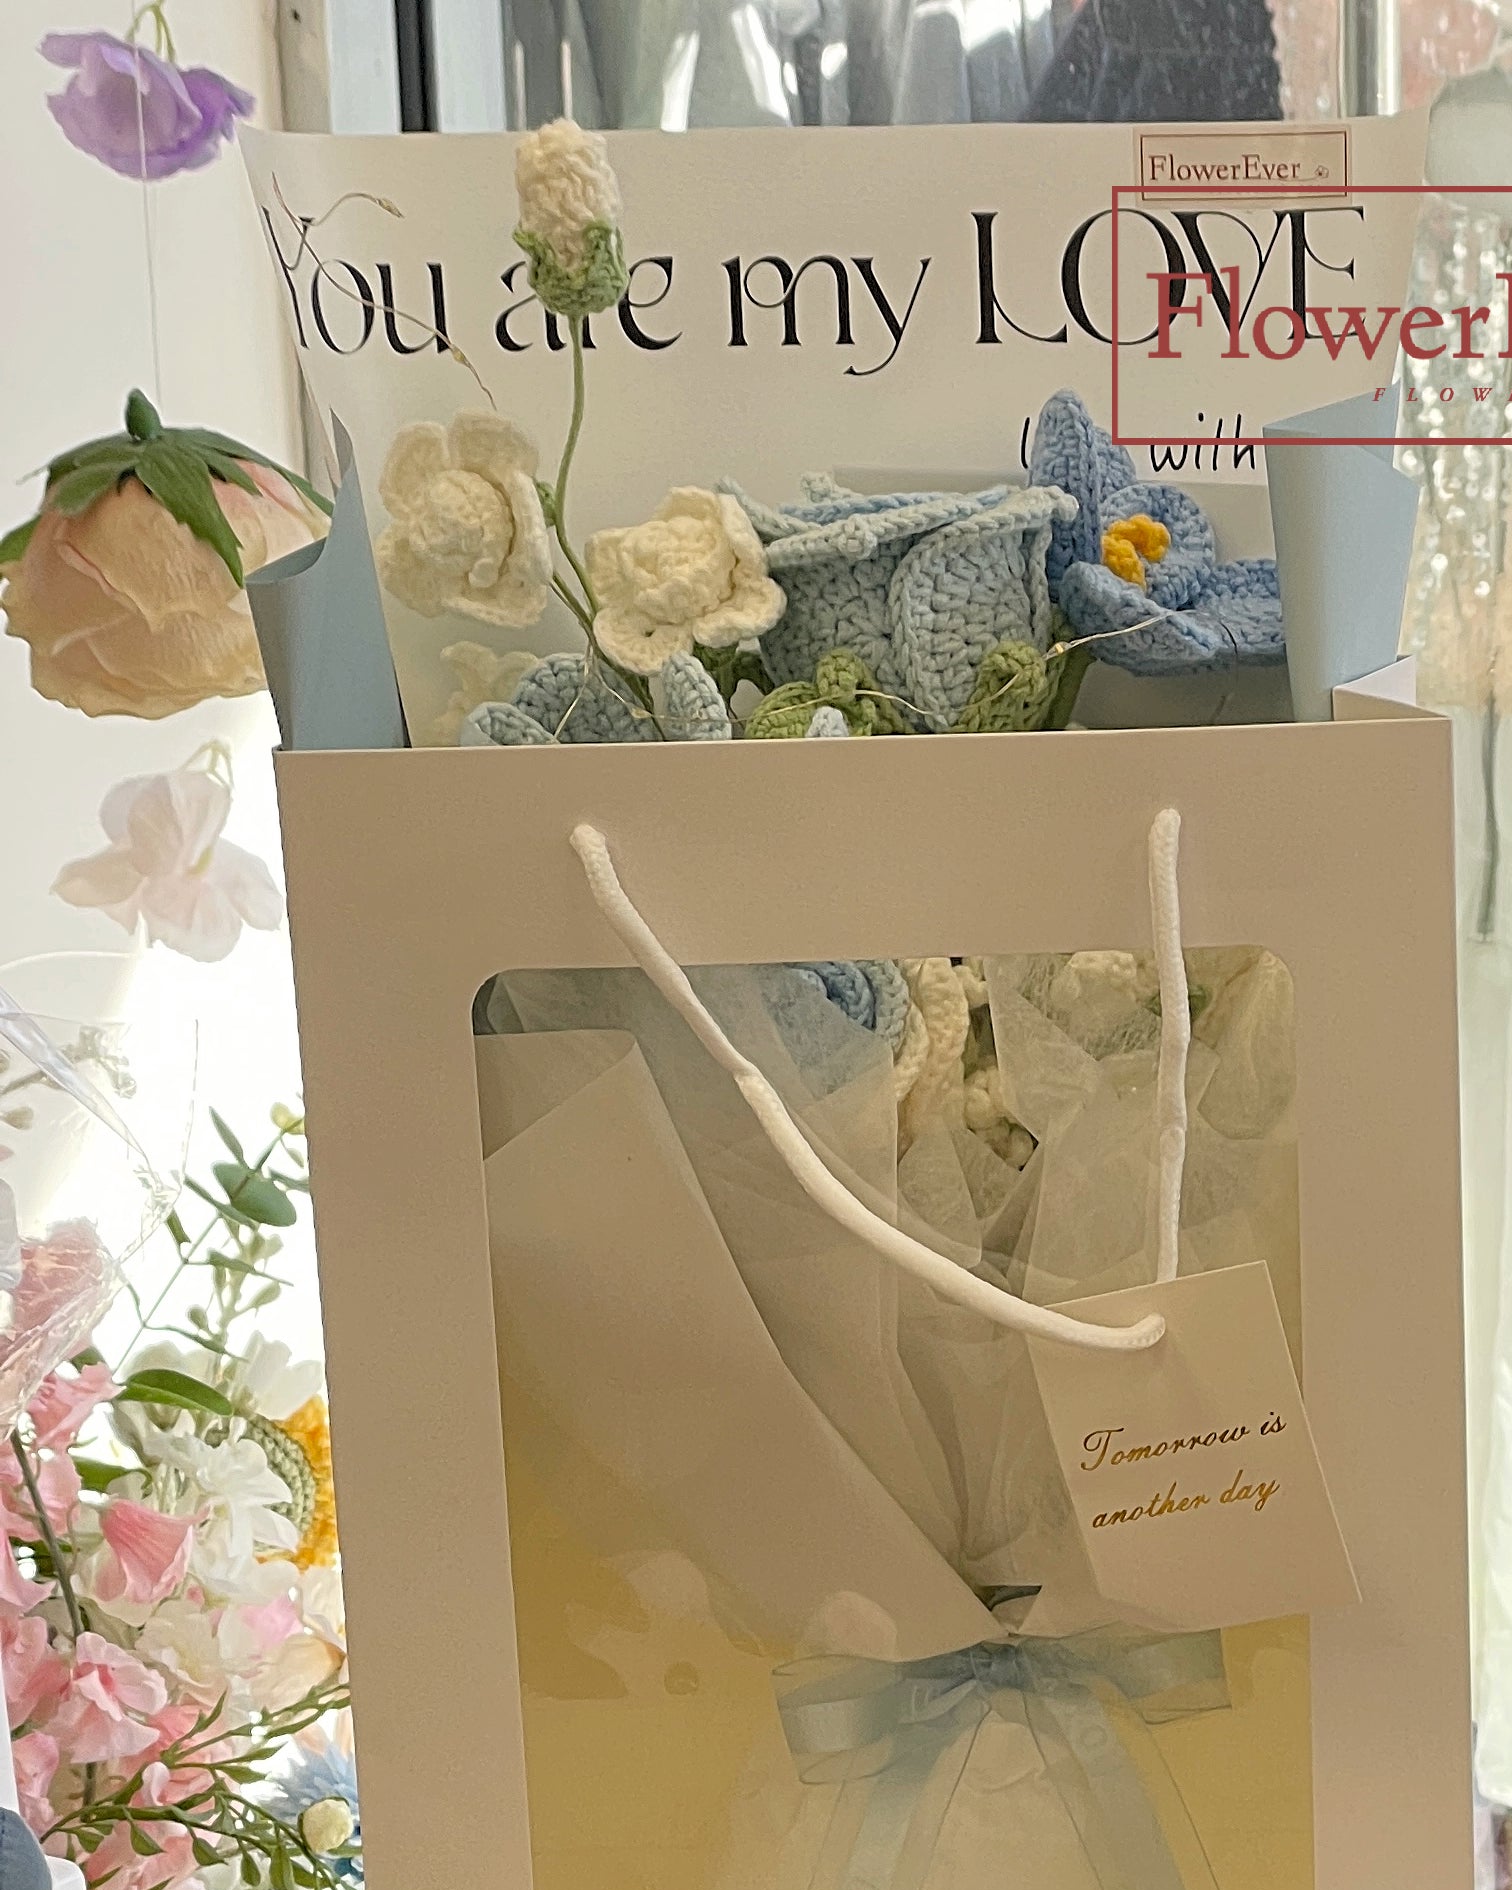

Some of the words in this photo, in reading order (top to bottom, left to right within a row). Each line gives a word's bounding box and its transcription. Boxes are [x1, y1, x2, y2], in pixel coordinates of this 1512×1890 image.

[1149, 153, 1301, 182] FlowerEver
[261, 204, 448, 355] You
[721, 255, 932, 376] my
[971, 205, 1367, 346] LOVE
[1080, 1426, 1251, 1472] Tomorrow
[1259, 1411, 1288, 1436] is
[1092, 1481, 1211, 1529] another
[1219, 1469, 1281, 1513] day
